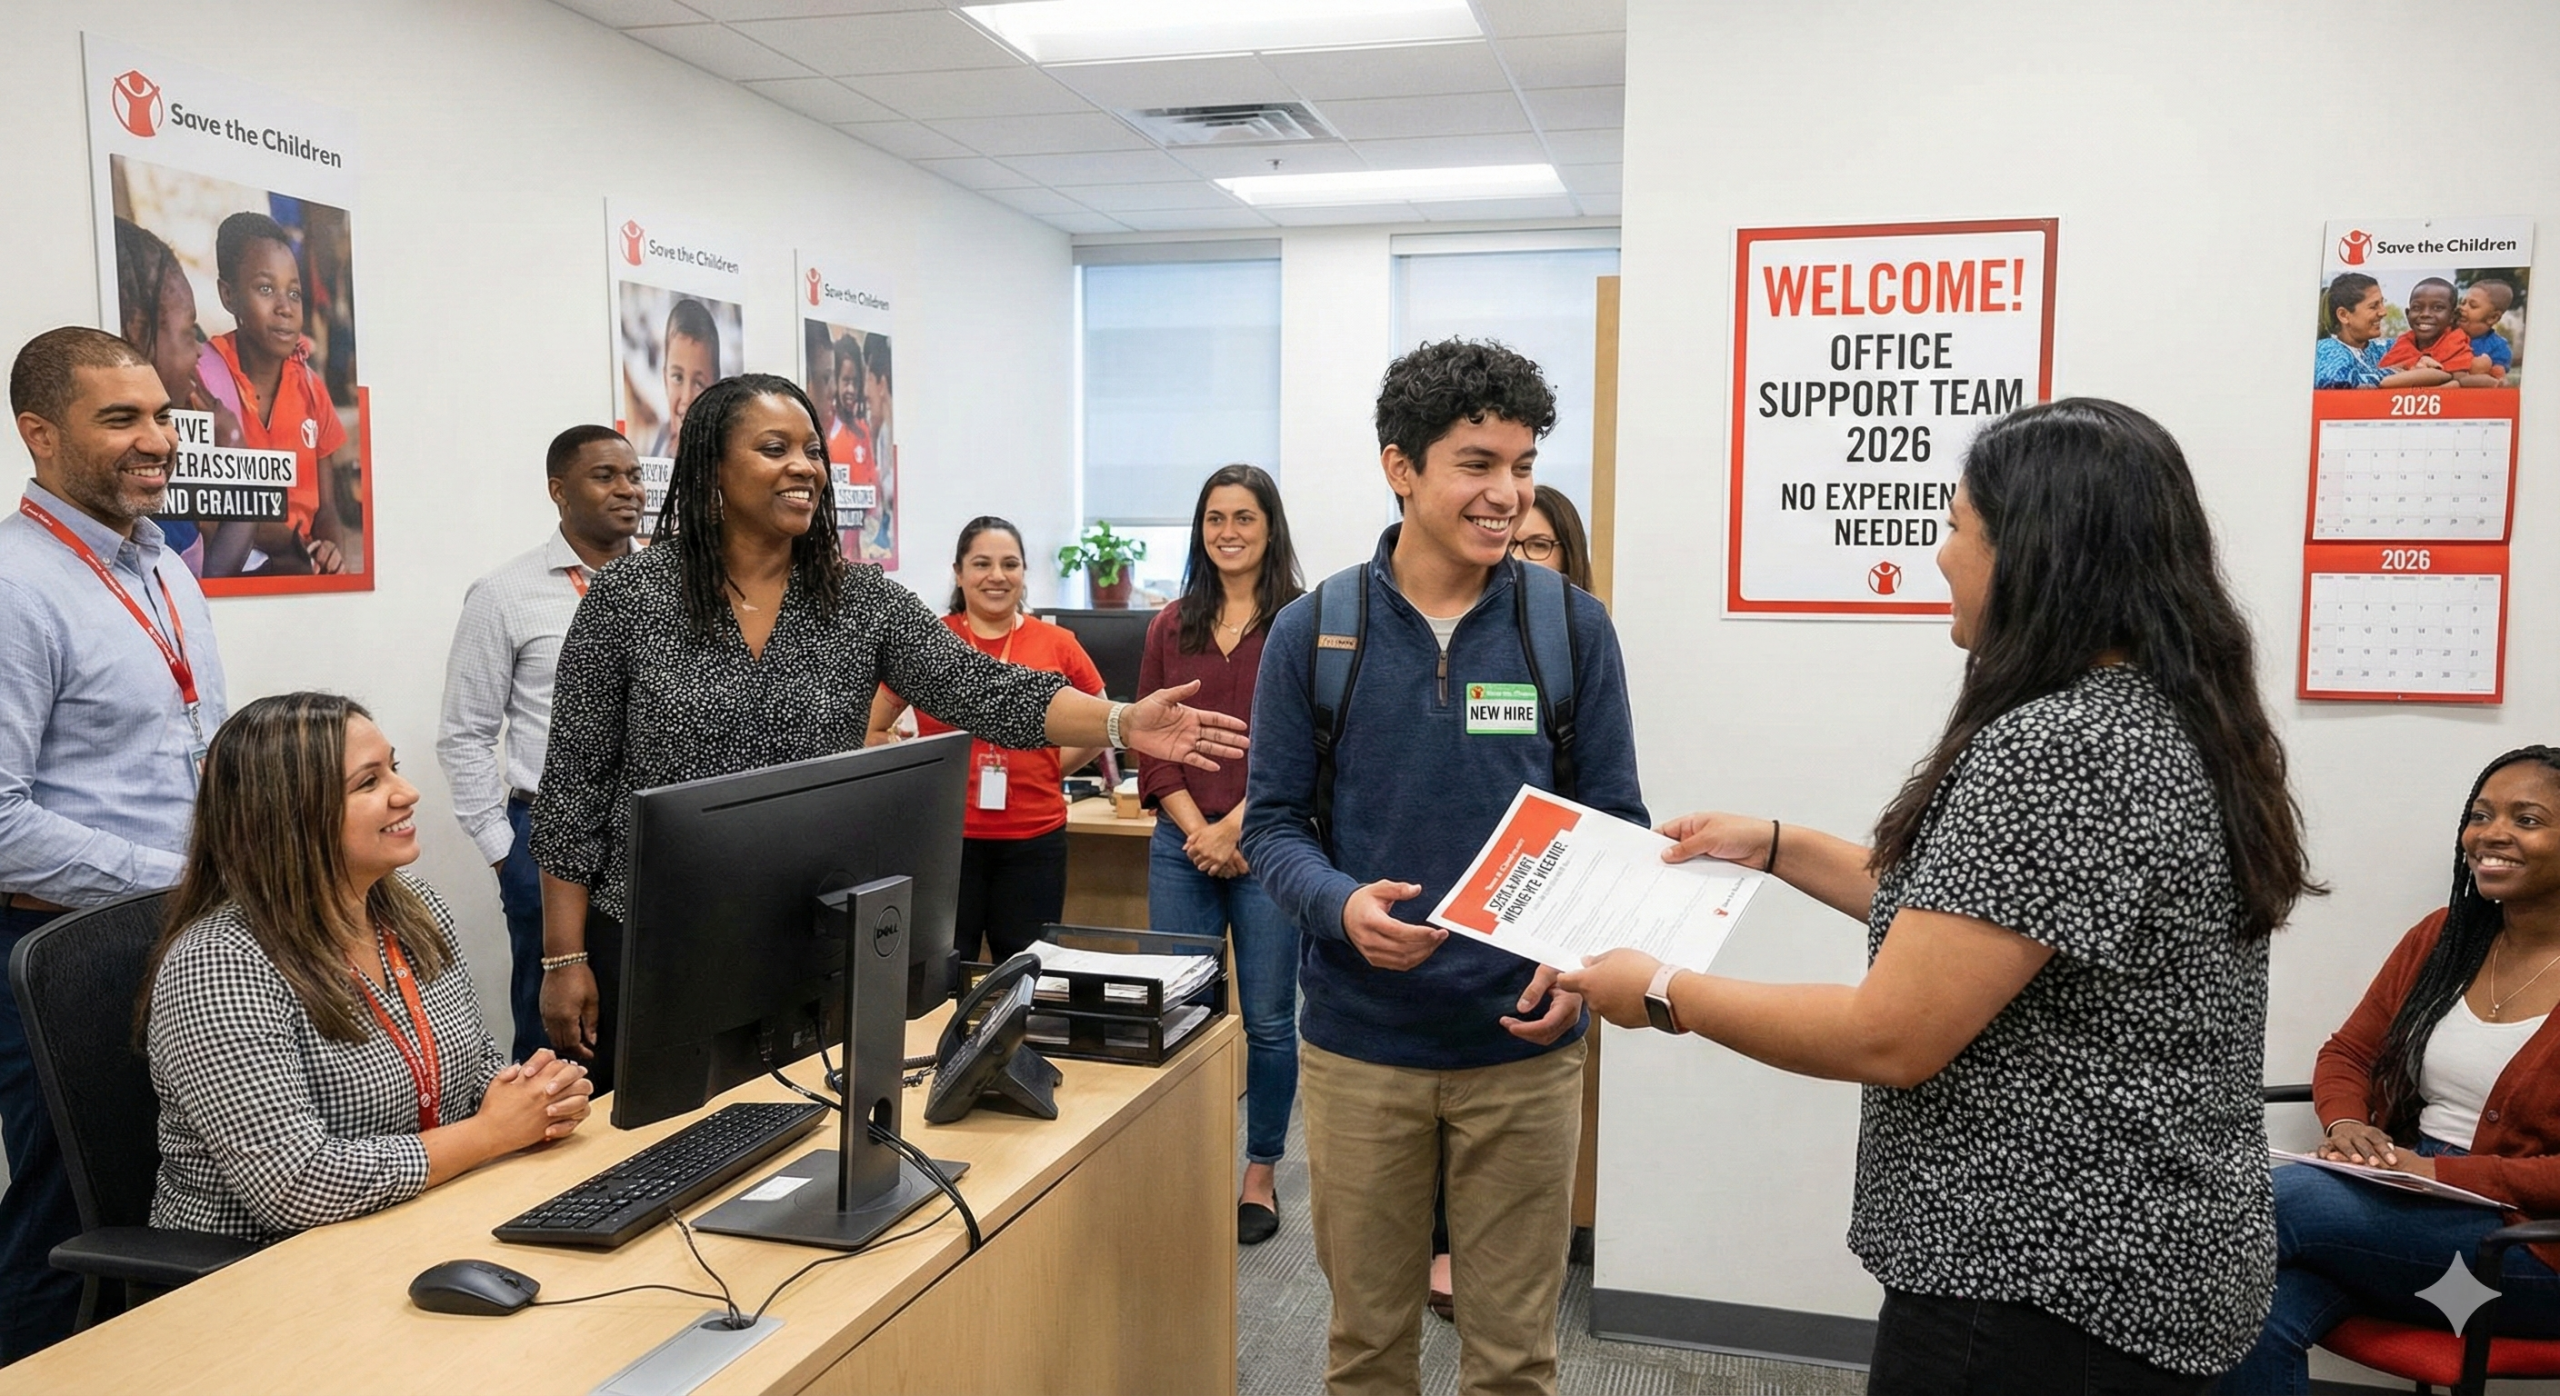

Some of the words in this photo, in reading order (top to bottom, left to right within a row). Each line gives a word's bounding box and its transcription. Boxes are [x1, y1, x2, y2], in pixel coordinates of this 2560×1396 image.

[170, 102, 221, 136] Save
[224, 119, 258, 146] the
[261, 128, 342, 168] Children
[2376, 241, 2415, 254] Save
[2417, 239, 2444, 253] the
[2446, 237, 2517, 252] Children
[1763, 258, 2025, 318] WELCOME!
[1830, 332, 1953, 371] OFFICE
[1759, 379, 1919, 418] SUPPORT
[1930, 378, 2023, 416] TEAM
[2390, 394, 2441, 416] 2026
[1846, 426, 1931, 462] 2026
[161, 488, 190, 515] ND
[1781, 483, 1816, 511] NO
[1825, 482, 1957, 511] EXPERIEN
[1834, 518, 1938, 547] NEEDED
[2381, 549, 2431, 570] 2026
[1470, 705, 1501, 721] NEW
[1503, 706, 1534, 721] HIRE
